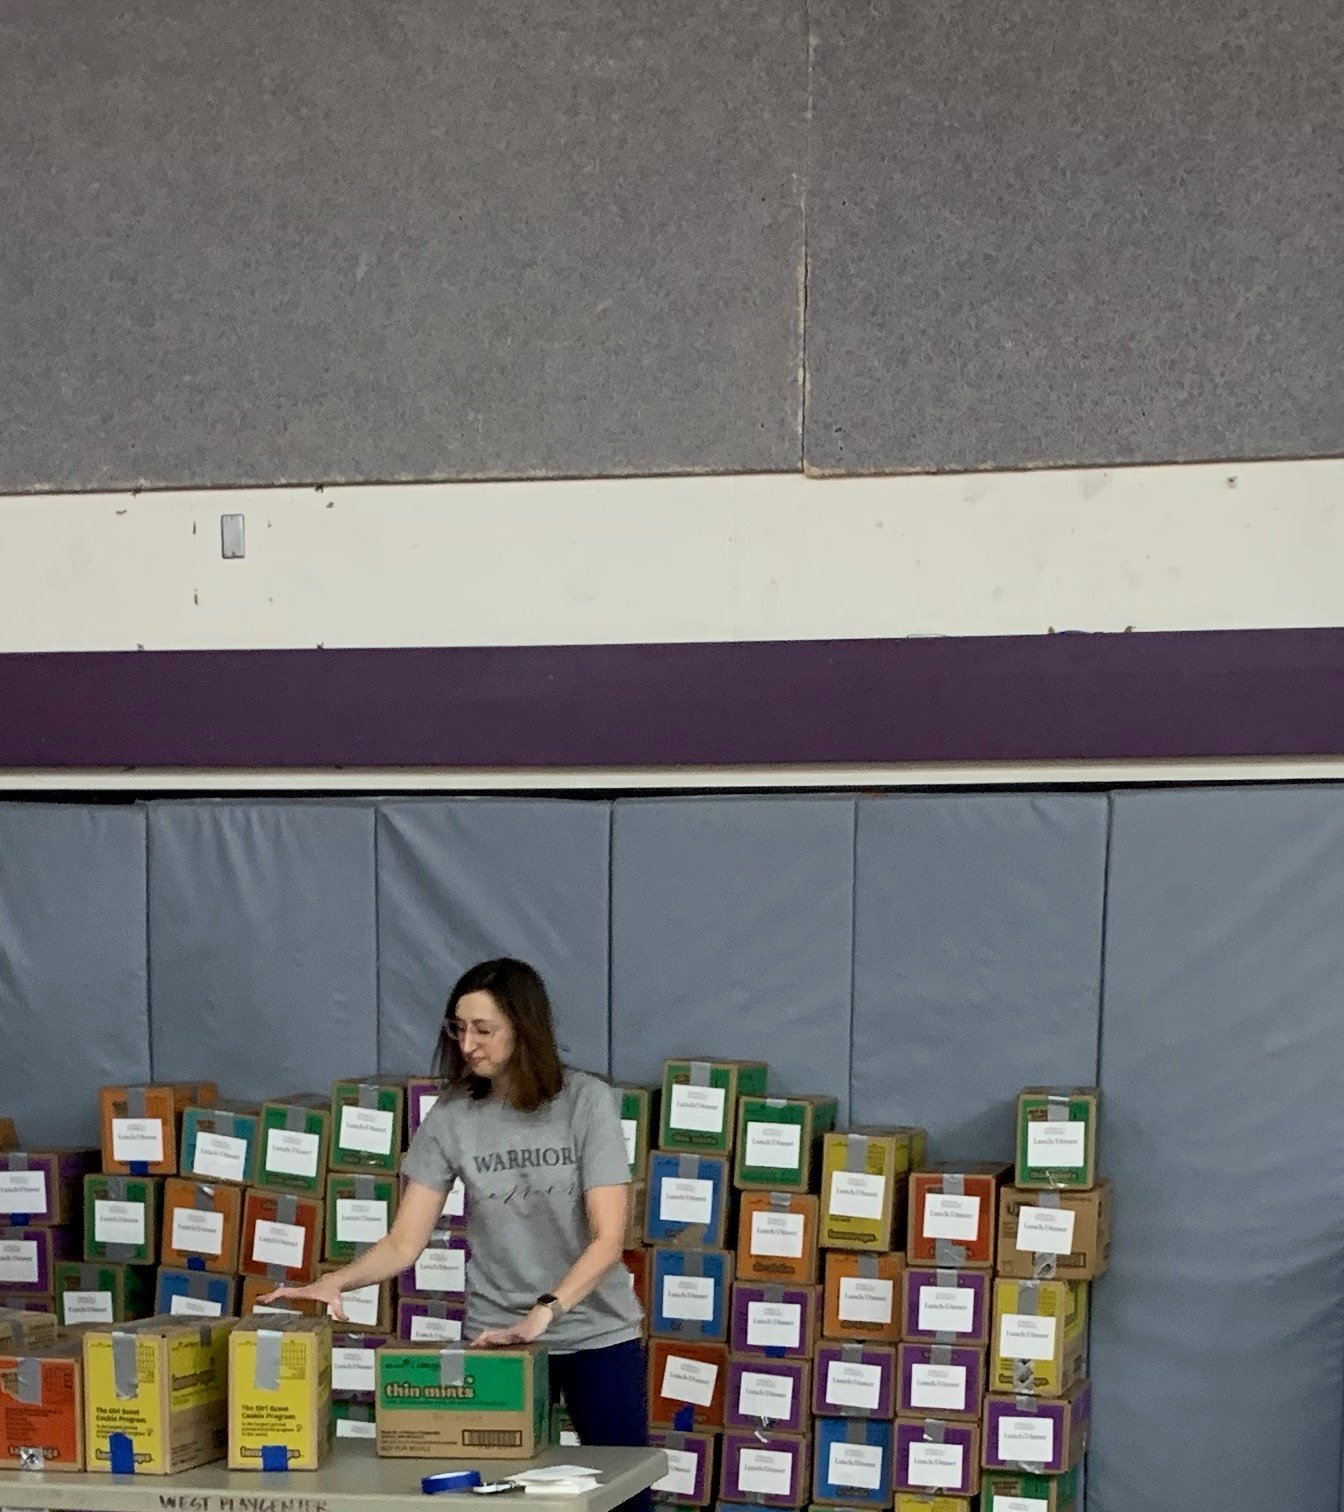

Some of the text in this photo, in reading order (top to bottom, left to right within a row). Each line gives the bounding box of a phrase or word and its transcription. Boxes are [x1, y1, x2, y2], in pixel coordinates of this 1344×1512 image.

[384, 1382, 475, 1399] thin mints
[159, 1495, 208, 1510] WEST
